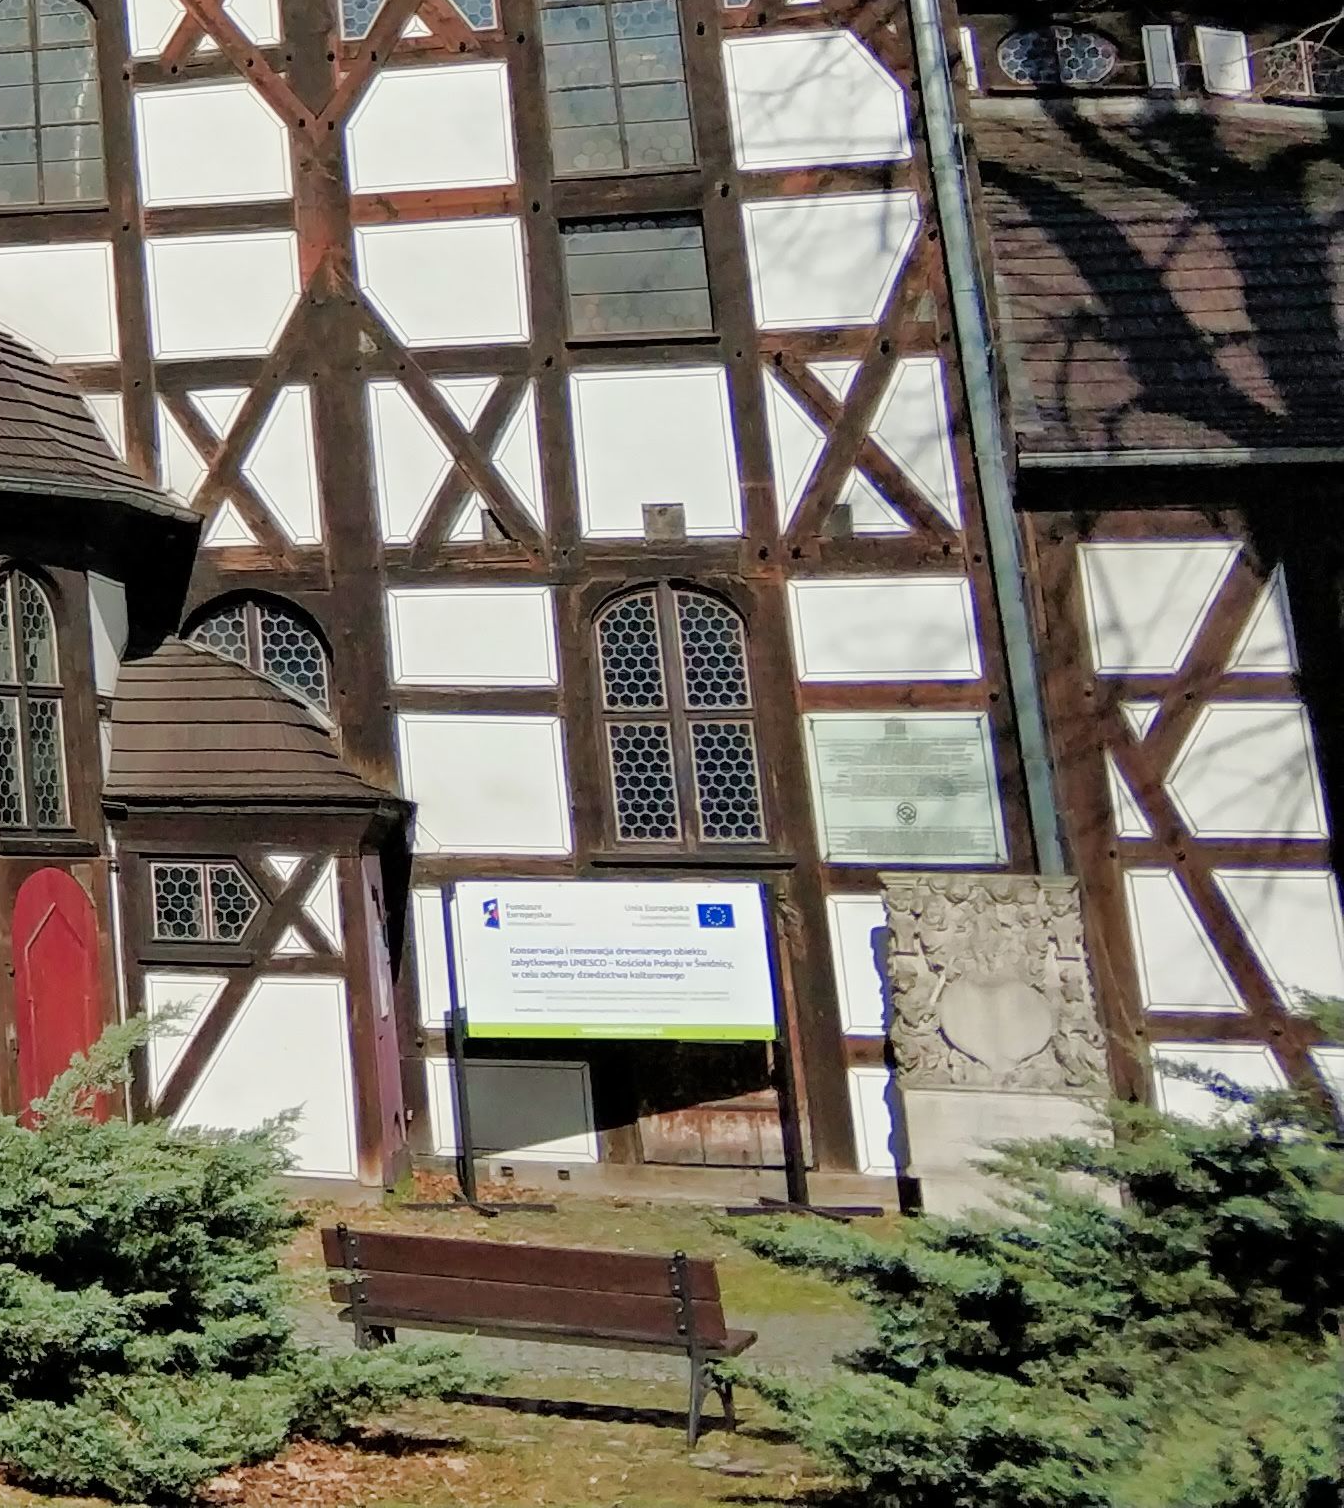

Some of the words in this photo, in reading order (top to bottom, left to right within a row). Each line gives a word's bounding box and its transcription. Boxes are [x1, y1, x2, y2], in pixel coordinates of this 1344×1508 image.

[509, 946, 564, 956] Konserwacja
[569, 947, 614, 956] renowacja
[615, 947, 672, 957] drewnianego
[673, 947, 708, 956] obiektu
[511, 958, 568, 968] zabytkowego
[569, 958, 607, 967] UNESCO
[615, 958, 652, 967] Kościoła
[654, 959, 684, 969] Pokoju
[520, 970, 538, 978] celu
[540, 970, 575, 980] ochrony
[577, 970, 628, 979] dziedzictwa
[629, 971, 685, 981] kulturowego
